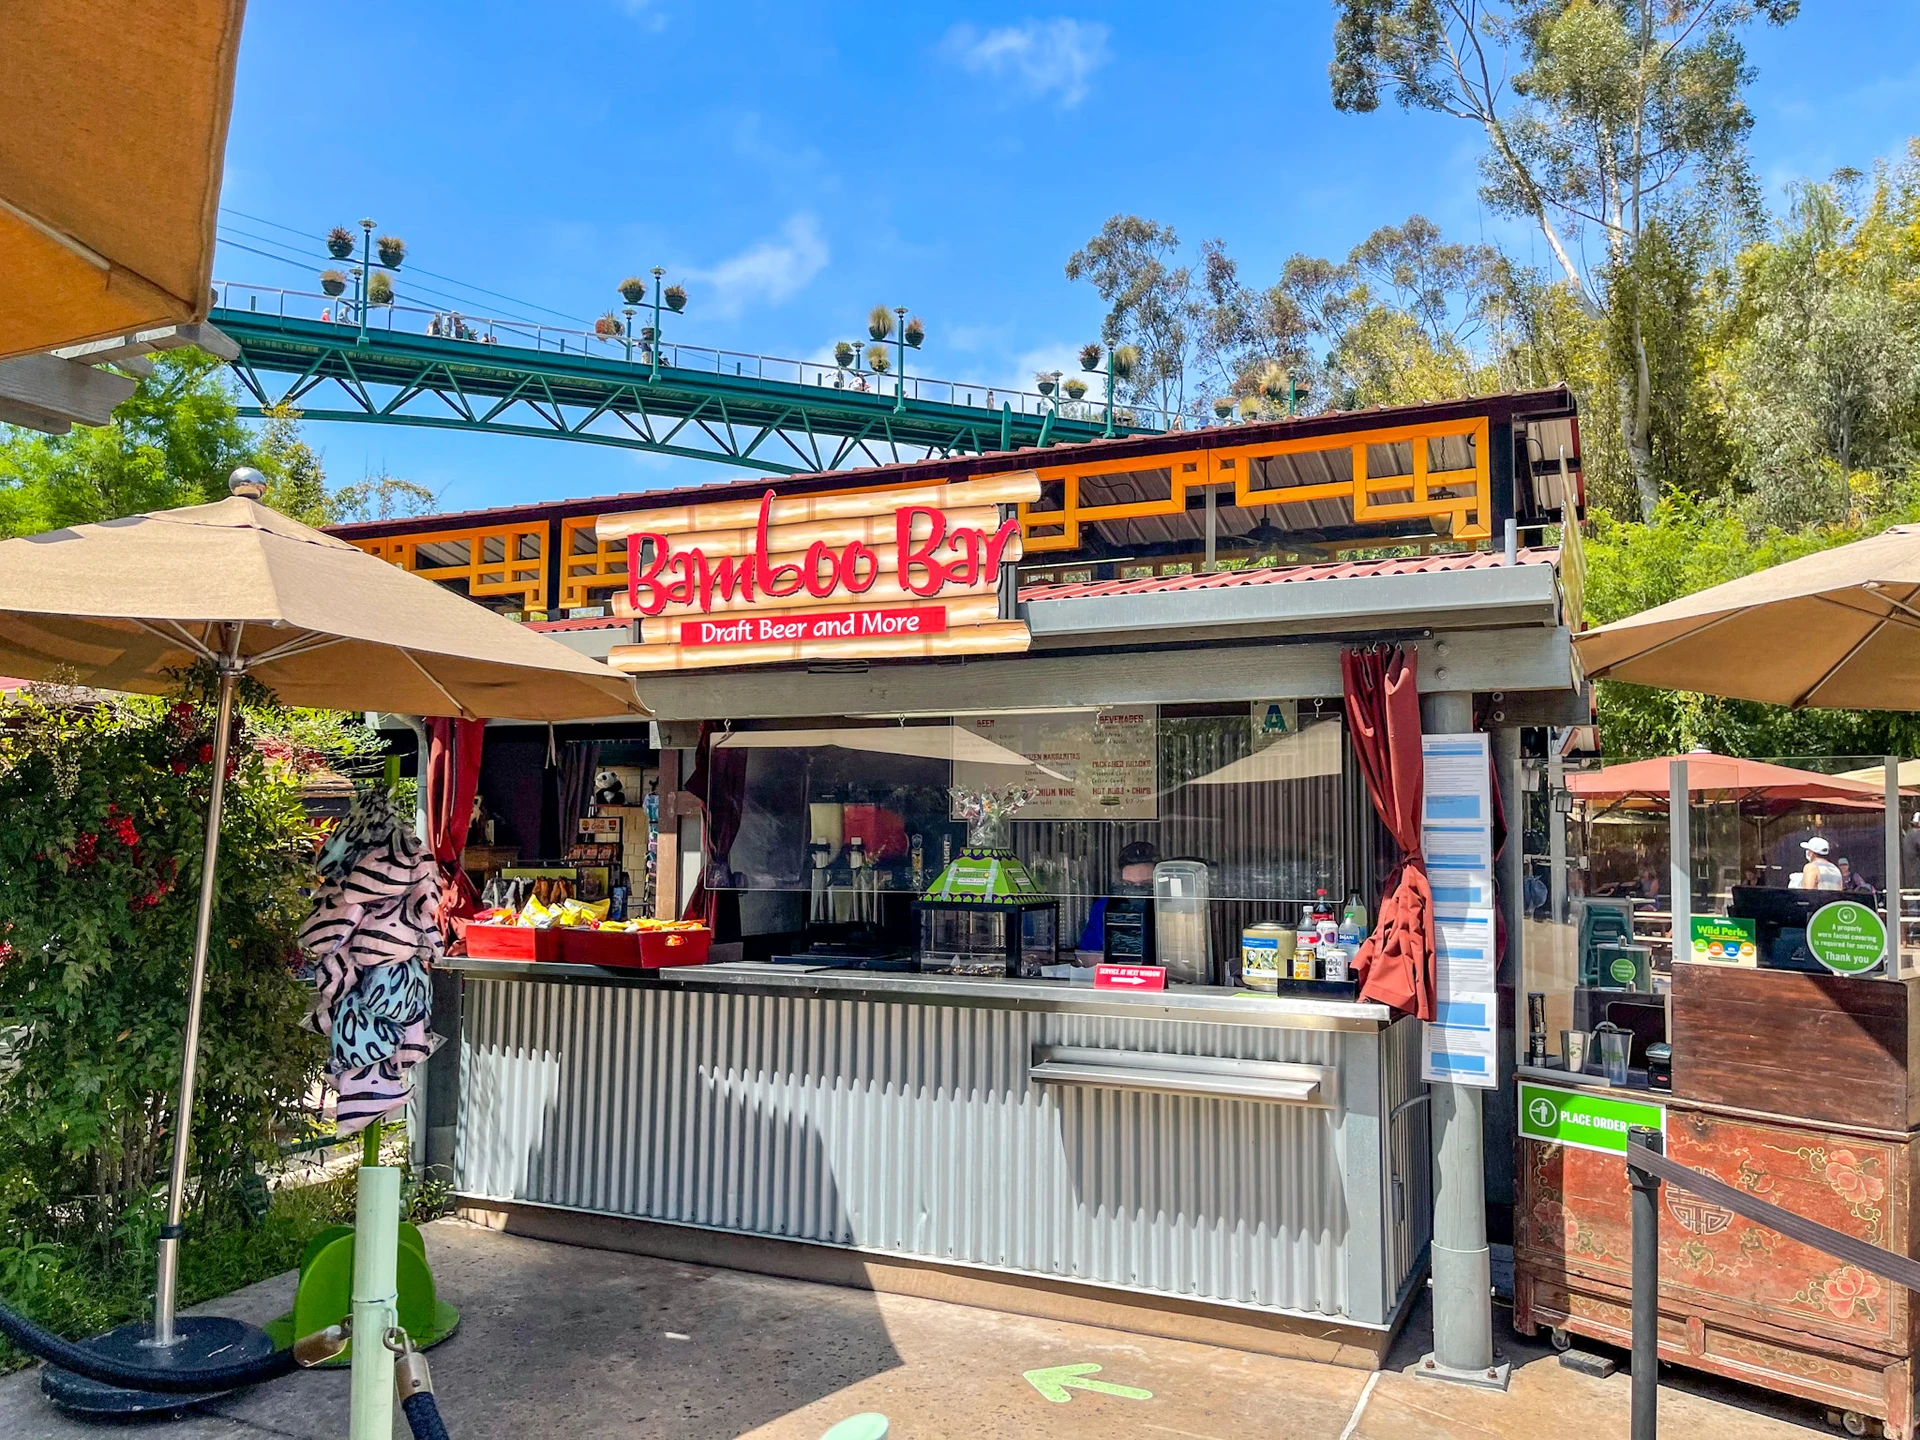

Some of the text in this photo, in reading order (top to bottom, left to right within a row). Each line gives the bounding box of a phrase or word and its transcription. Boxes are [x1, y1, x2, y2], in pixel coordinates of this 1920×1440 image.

[627, 489, 1022, 615] Bamboo Bar
[701, 612, 920, 644] Draft Beer and More
[1262, 704, 1288, 733] A
[1058, 788, 1076, 796] WINE
[1696, 925, 1748, 936] Wild Perks
[1851, 935, 1877, 943] covering
[1825, 951, 1870, 964] Thank you
[1560, 1110, 1627, 1132] PLACE ORDER
